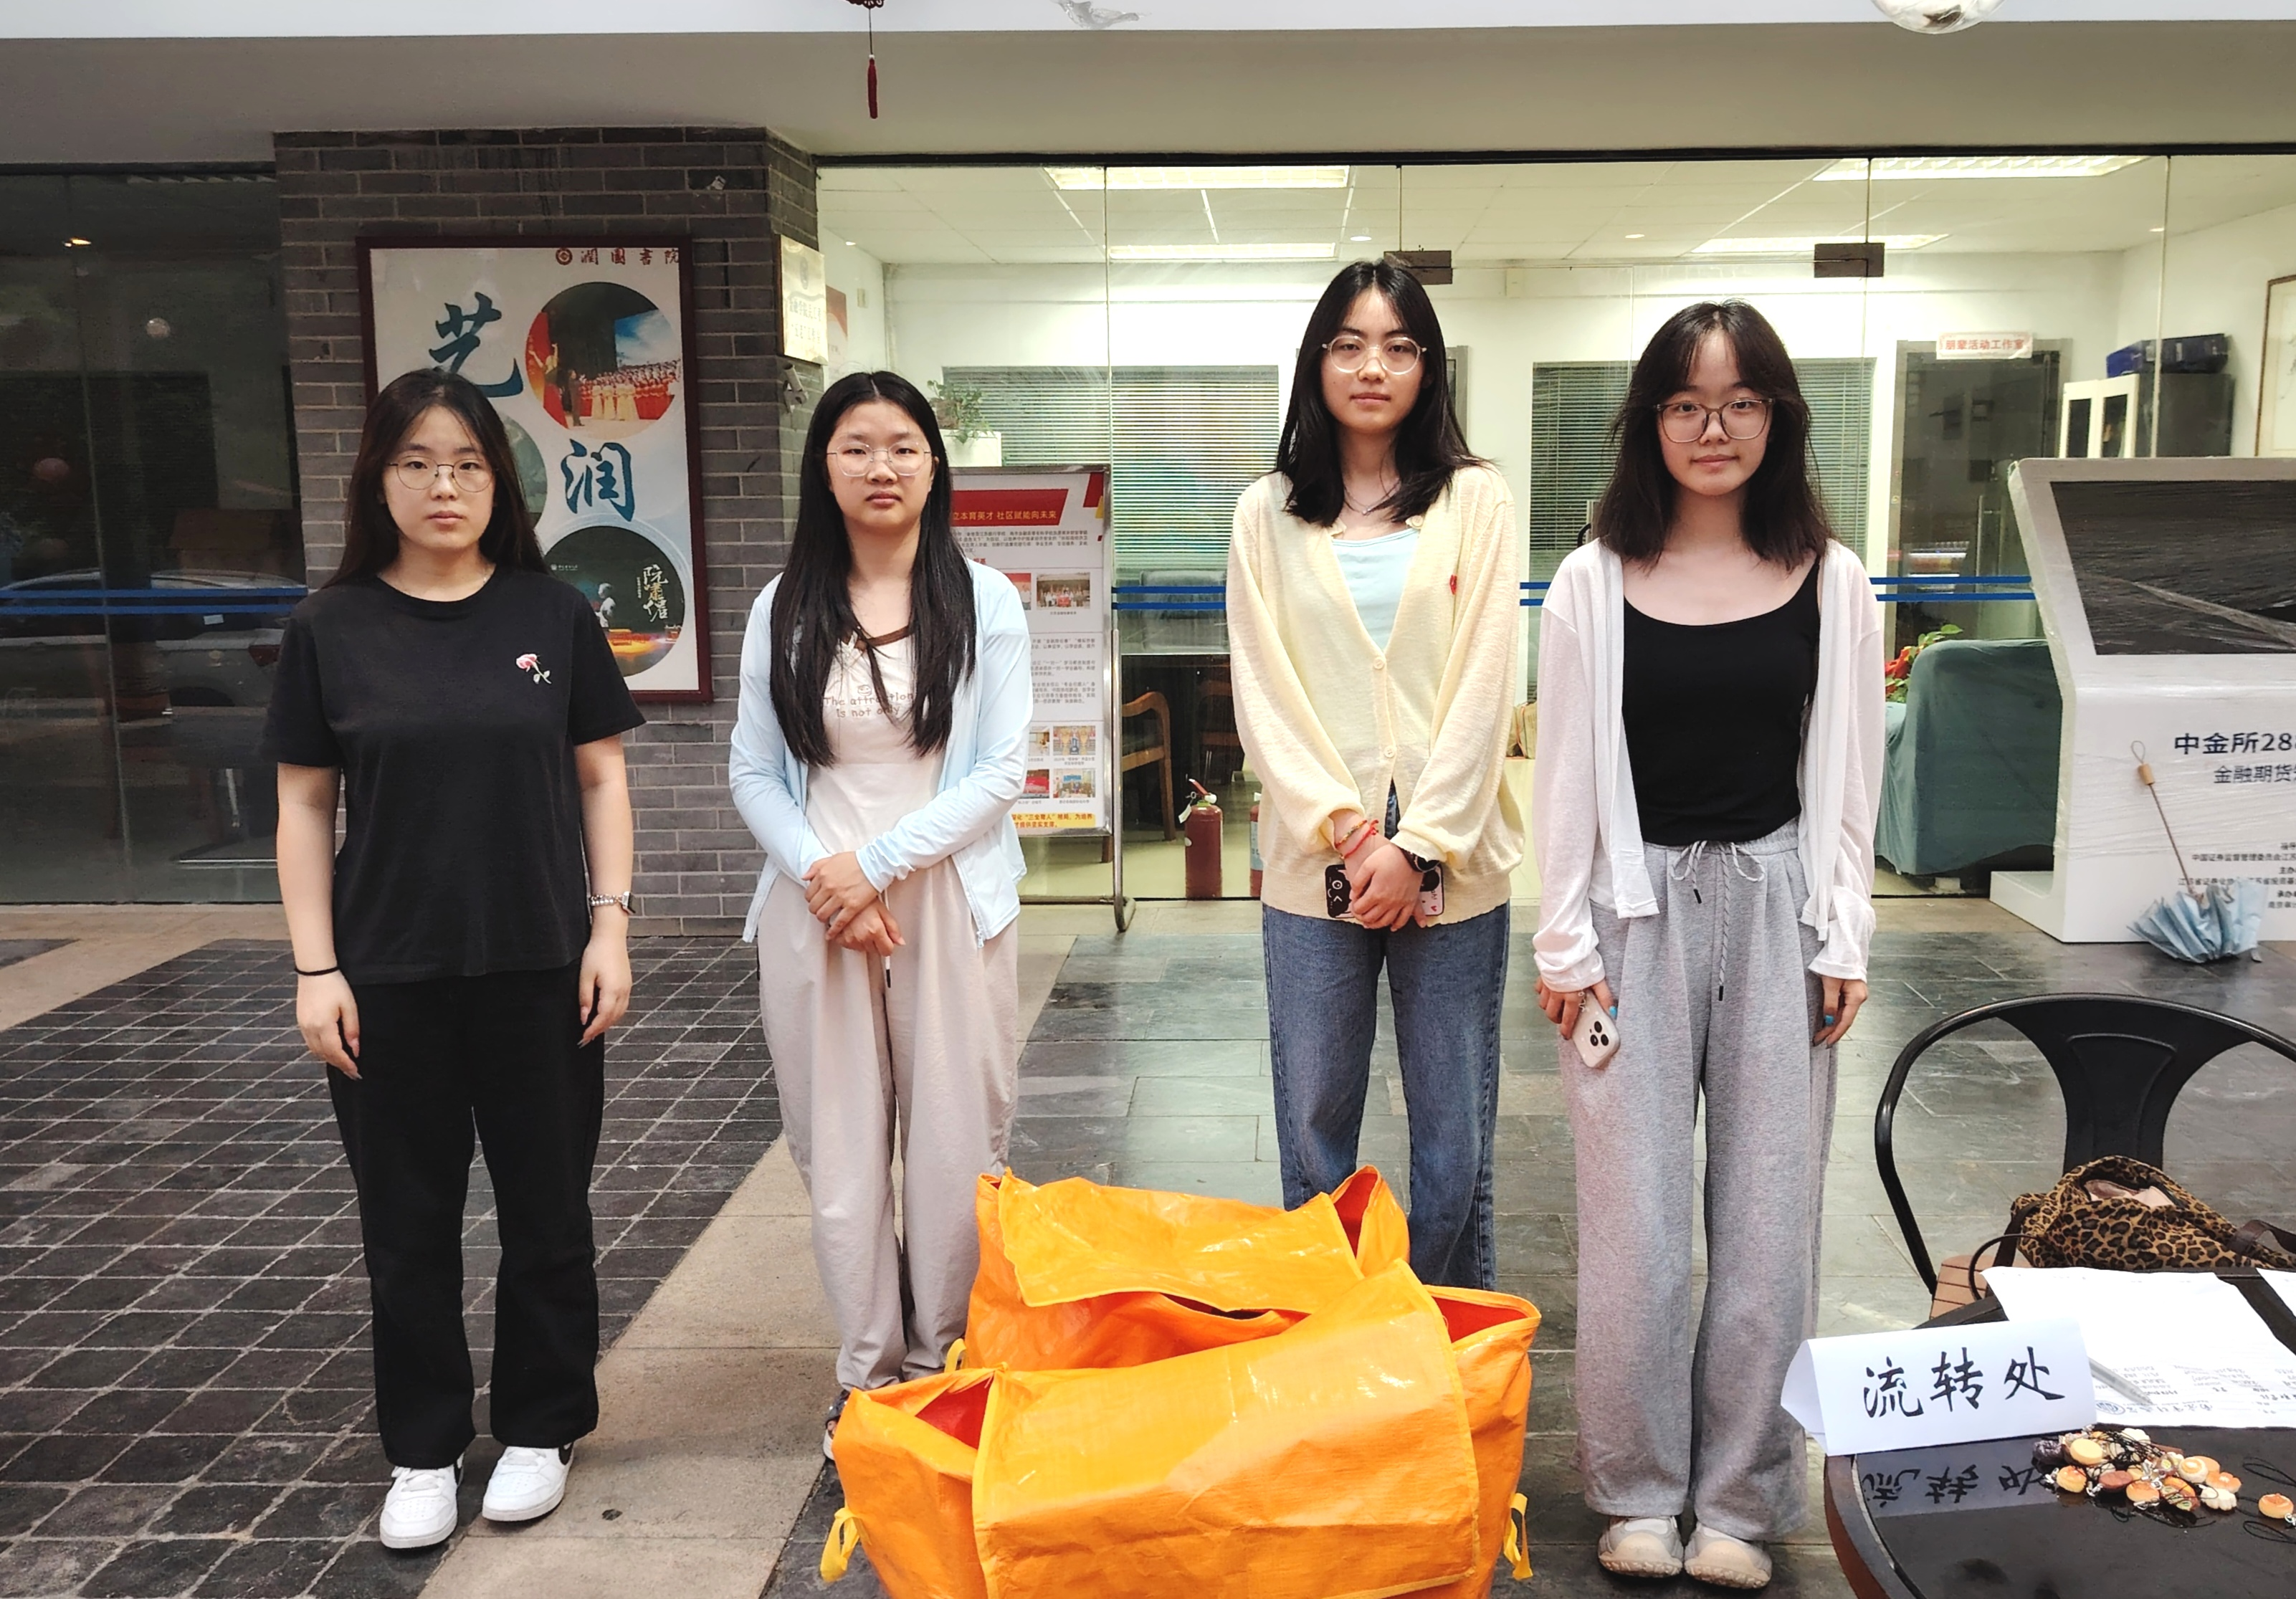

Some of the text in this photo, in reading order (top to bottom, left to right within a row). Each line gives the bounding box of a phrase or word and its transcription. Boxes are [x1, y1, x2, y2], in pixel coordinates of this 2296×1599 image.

[429, 292, 523, 398] 艺
[1945, 338, 2024, 350] 朋辈活动工作室
[561, 439, 635, 522] 润
[997, 510, 1057, 520] 社区赋能向未来
[824, 696, 845, 706] The
[852, 707, 872, 717] not
[2175, 732, 2296, 755] 中金所28
[2214, 764, 2296, 783] 金融期货
[1864, 1346, 2065, 1418] 流转处
